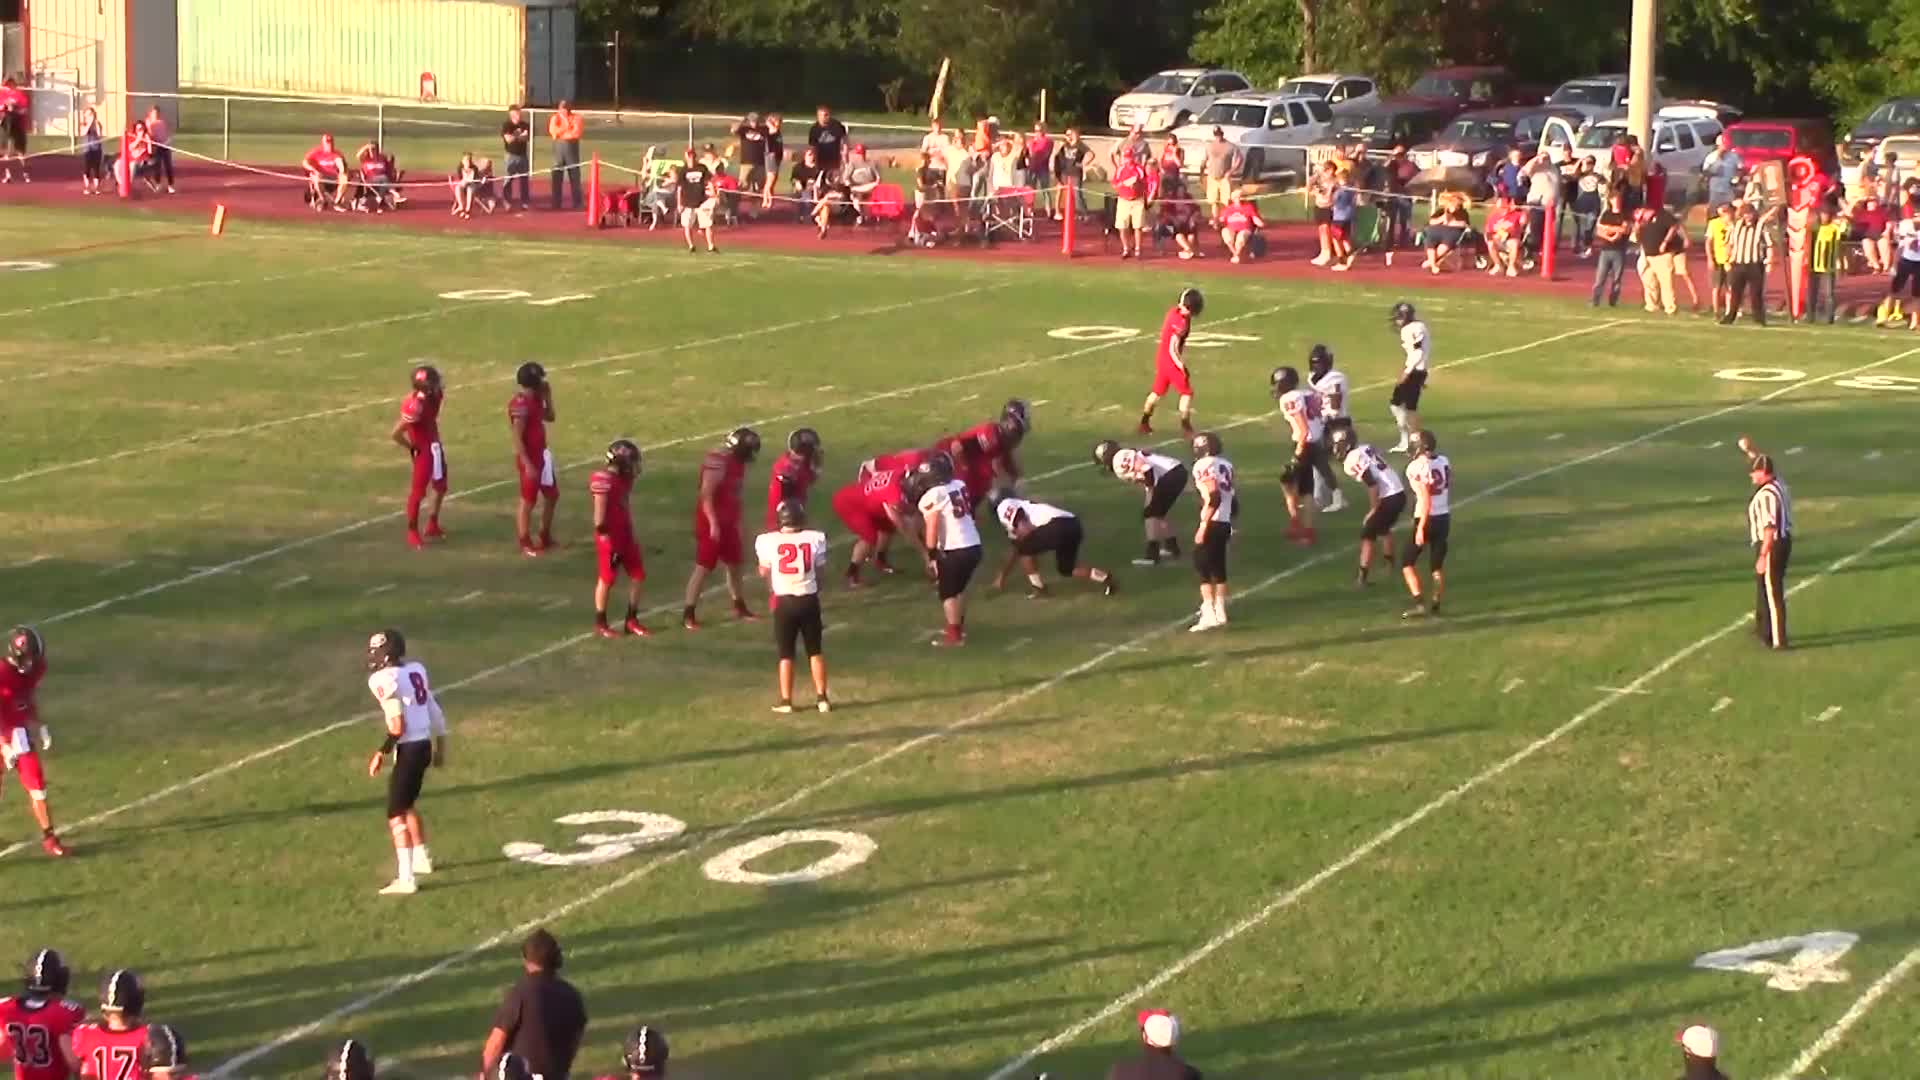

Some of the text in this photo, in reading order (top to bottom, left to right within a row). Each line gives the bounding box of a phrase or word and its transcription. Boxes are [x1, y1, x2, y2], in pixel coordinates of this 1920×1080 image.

[777, 542, 812, 575] 21
[408, 671, 428, 706] 8
[502, 809, 879, 886] 30
[7, 1022, 52, 1068] 33
[92, 1045, 138, 1080] 17
